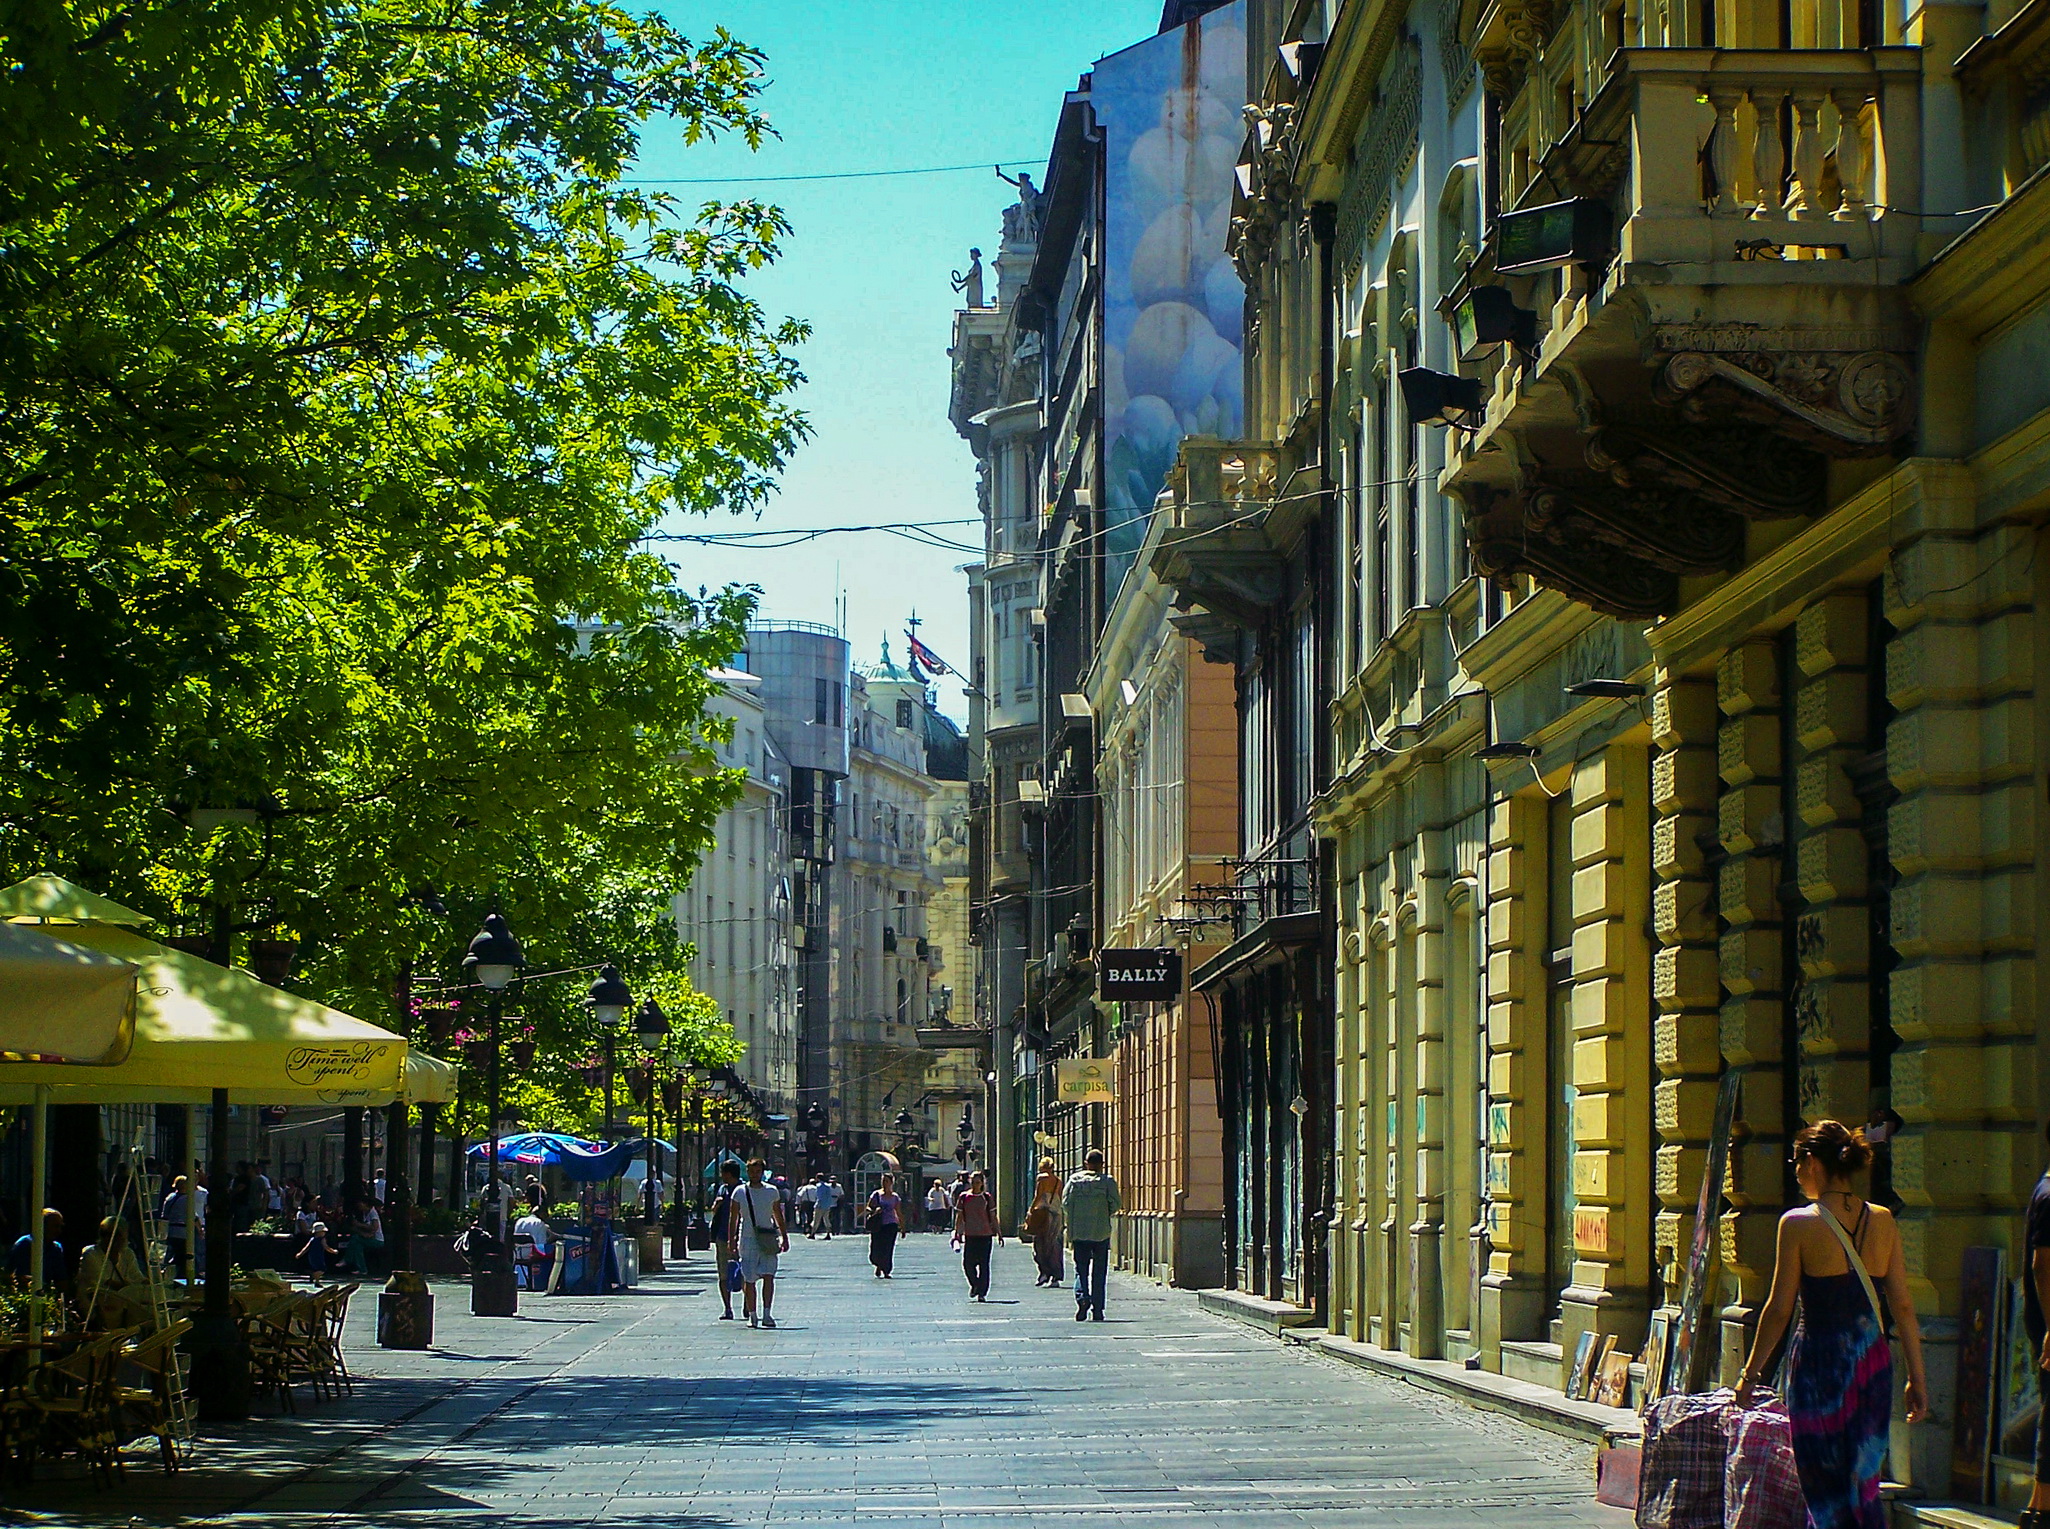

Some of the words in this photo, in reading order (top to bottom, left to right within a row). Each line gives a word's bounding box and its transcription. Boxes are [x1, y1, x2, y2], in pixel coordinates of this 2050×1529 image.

[1108, 969, 1168, 982] BALLY
[286, 1047, 338, 1071] Time
[342, 1042, 388, 1064] well
[314, 1064, 370, 1082] spent
[1063, 1080, 1109, 1095] carpisa
